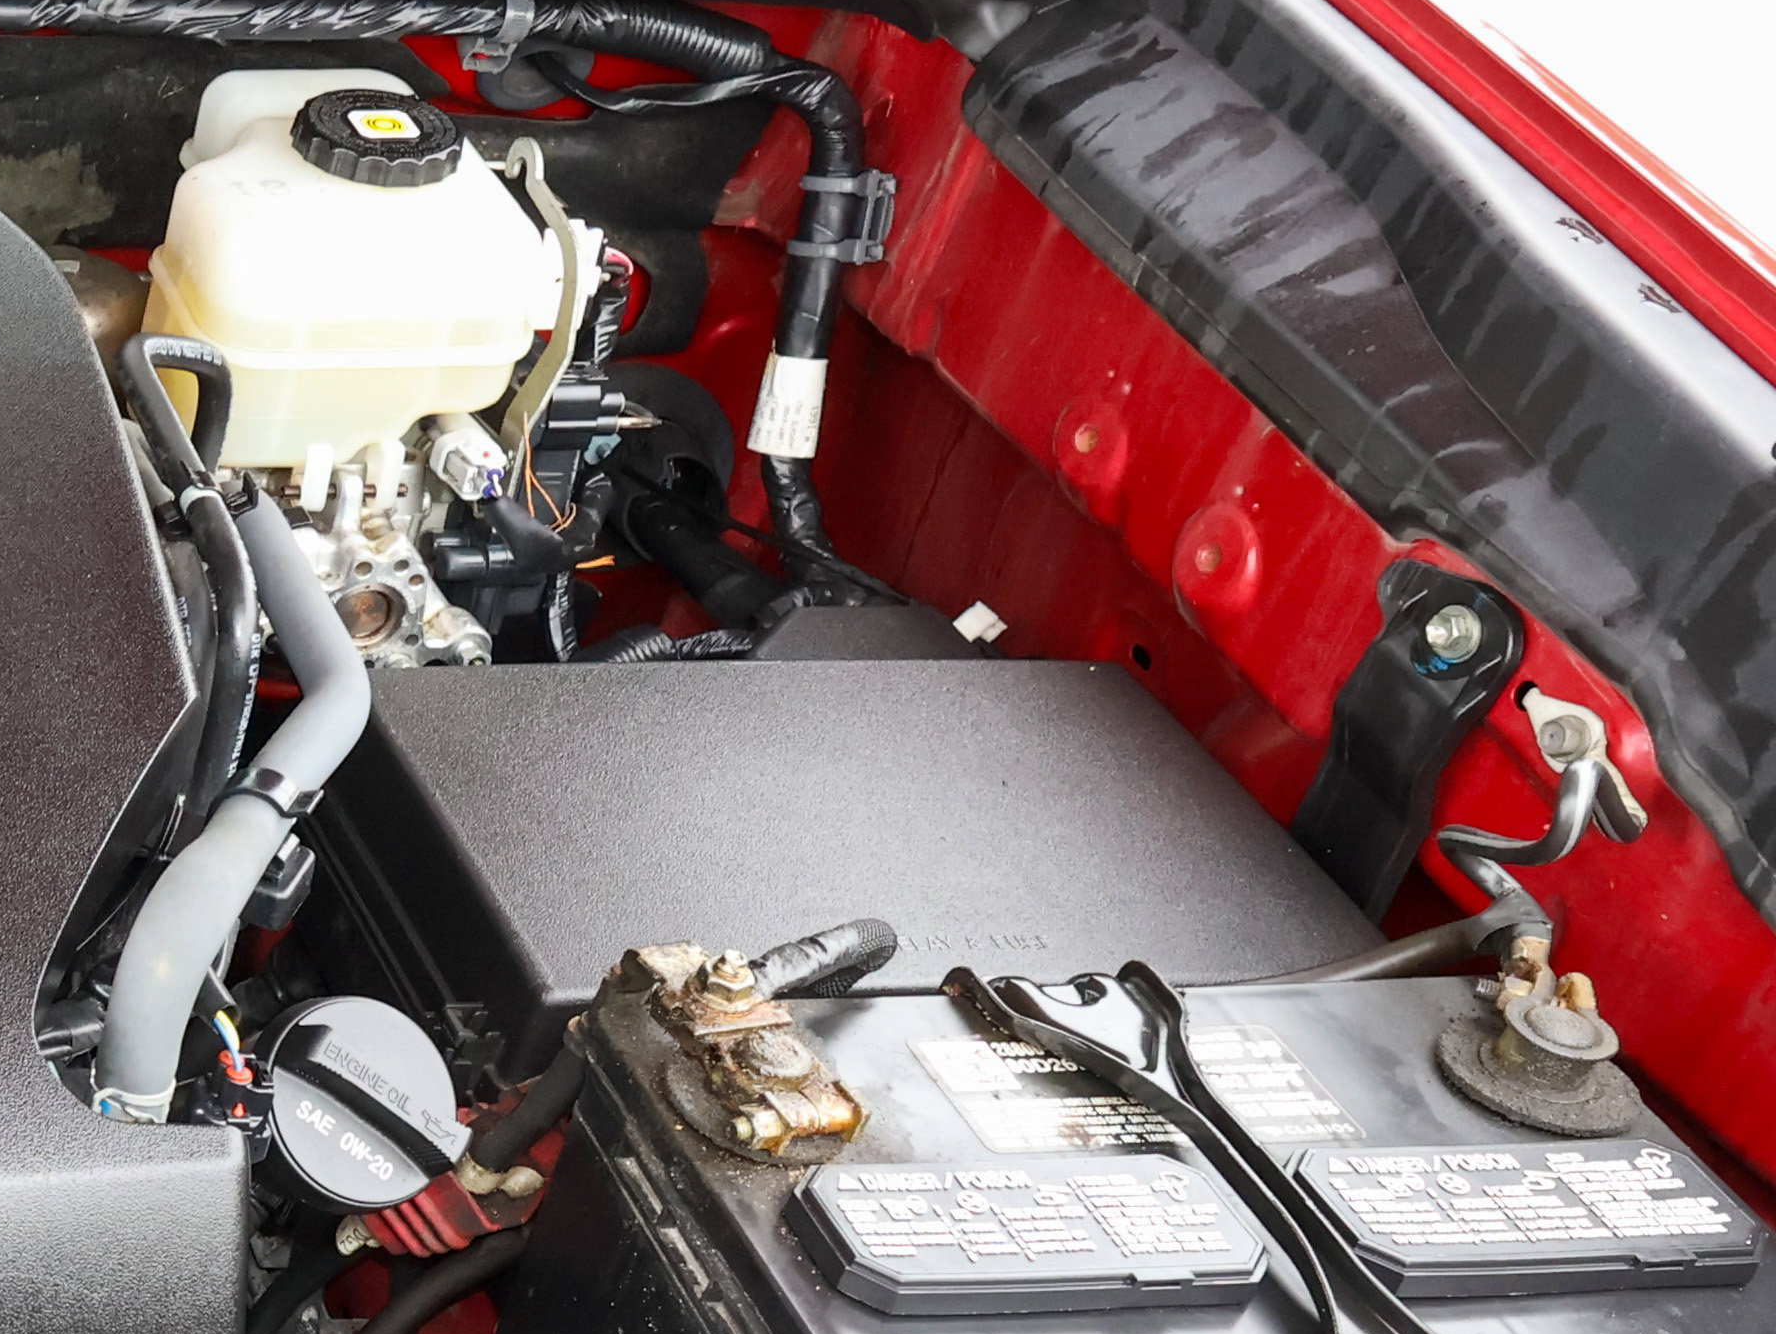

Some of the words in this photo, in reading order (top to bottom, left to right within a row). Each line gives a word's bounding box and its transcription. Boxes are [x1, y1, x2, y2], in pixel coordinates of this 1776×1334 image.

[323, 1040, 388, 1095] ENGINE
[387, 1086, 411, 1116] OIL
[1282, 1122, 1356, 1136] CLARIOS
[296, 1100, 336, 1136] SAE
[339, 1131, 394, 1181] 0W-20
[1348, 1156, 1432, 1174] DANGER
[1441, 1153, 1521, 1171] POISON
[857, 1172, 943, 1191] DANGER
[953, 1170, 1034, 1189] POISON
